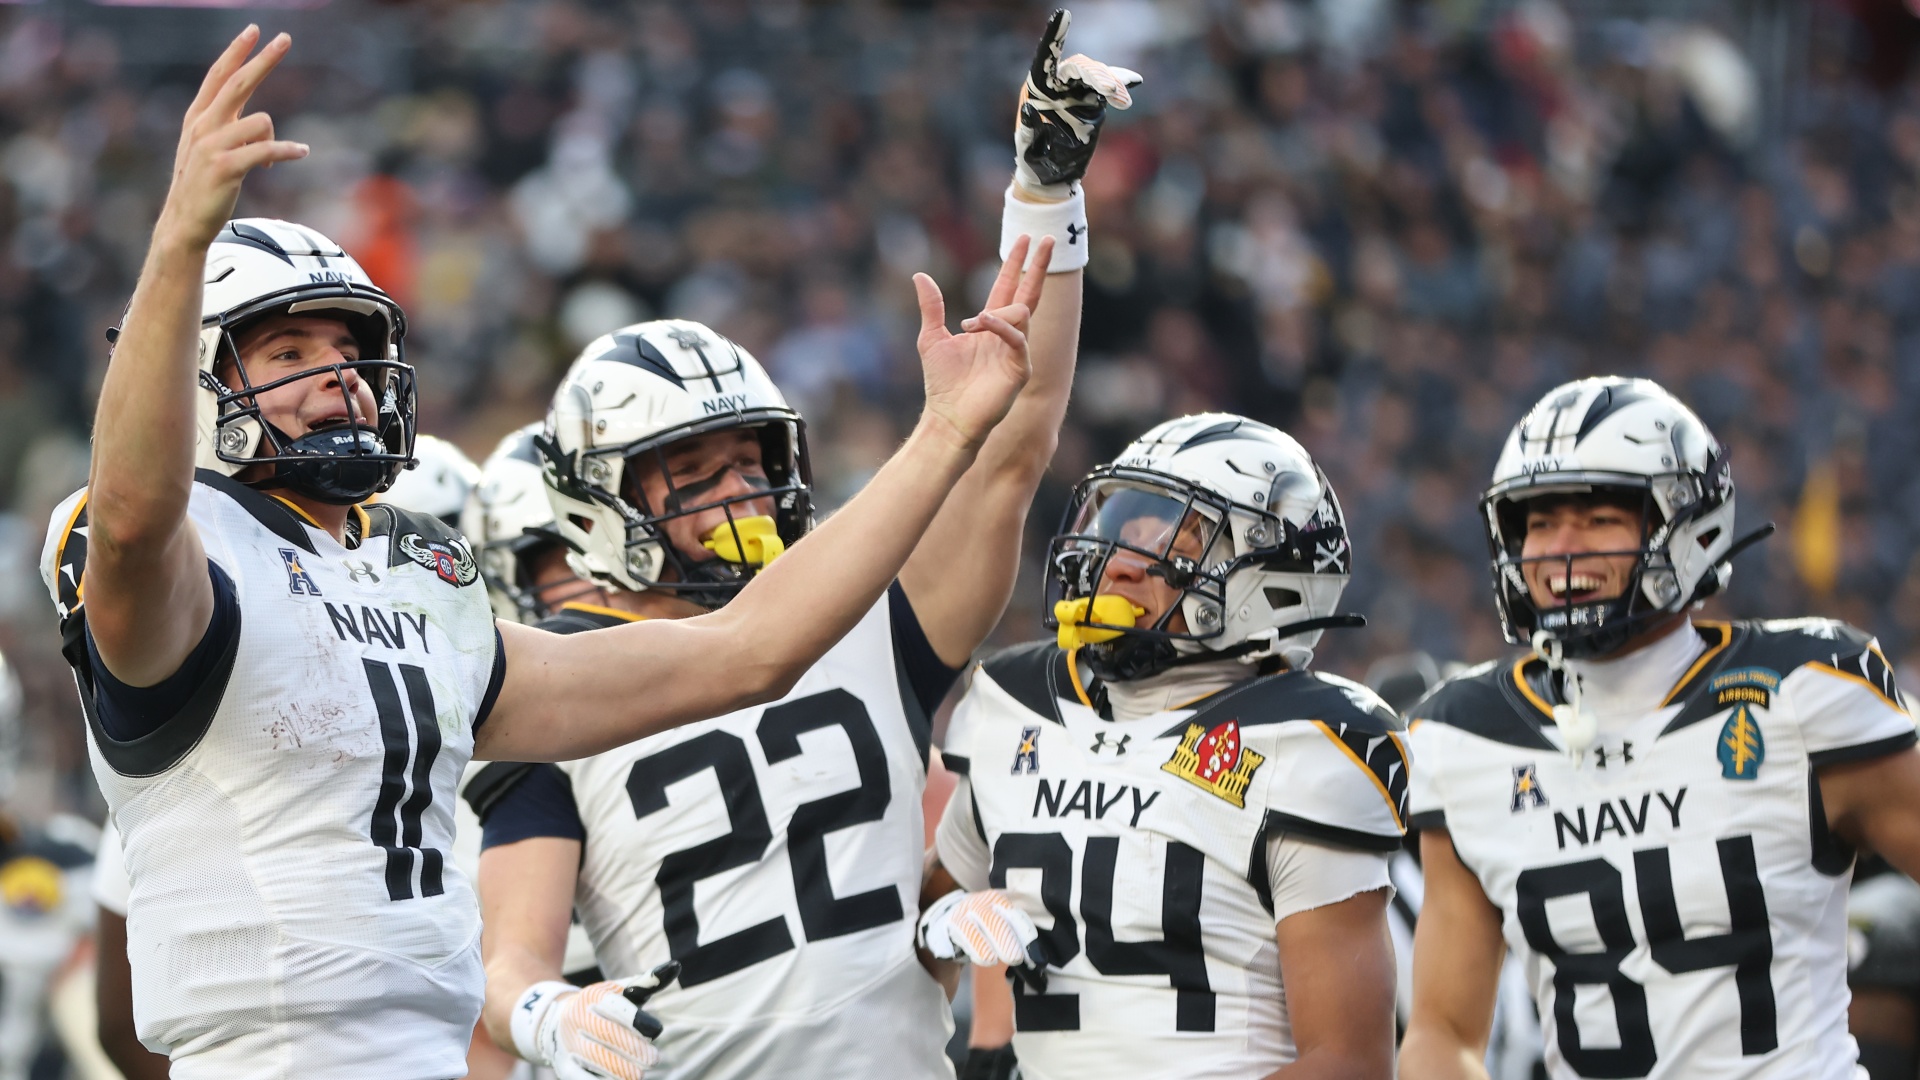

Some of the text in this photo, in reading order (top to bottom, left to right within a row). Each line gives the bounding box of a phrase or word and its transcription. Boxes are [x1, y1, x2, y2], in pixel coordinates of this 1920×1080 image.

[702, 394, 747, 414] NAVY
[323, 601, 431, 655] NAVY
[1714, 671, 1777, 689] SPECIAL FORCES
[1719, 687, 1765, 705] AIRBORNE
[362, 657, 445, 902] 11
[1032, 778, 1161, 828] NAVY
[625, 687, 905, 990] 22
[1553, 785, 1689, 851] NAVY
[989, 832, 1216, 1033] 24
[1516, 833, 1779, 1080] 84
